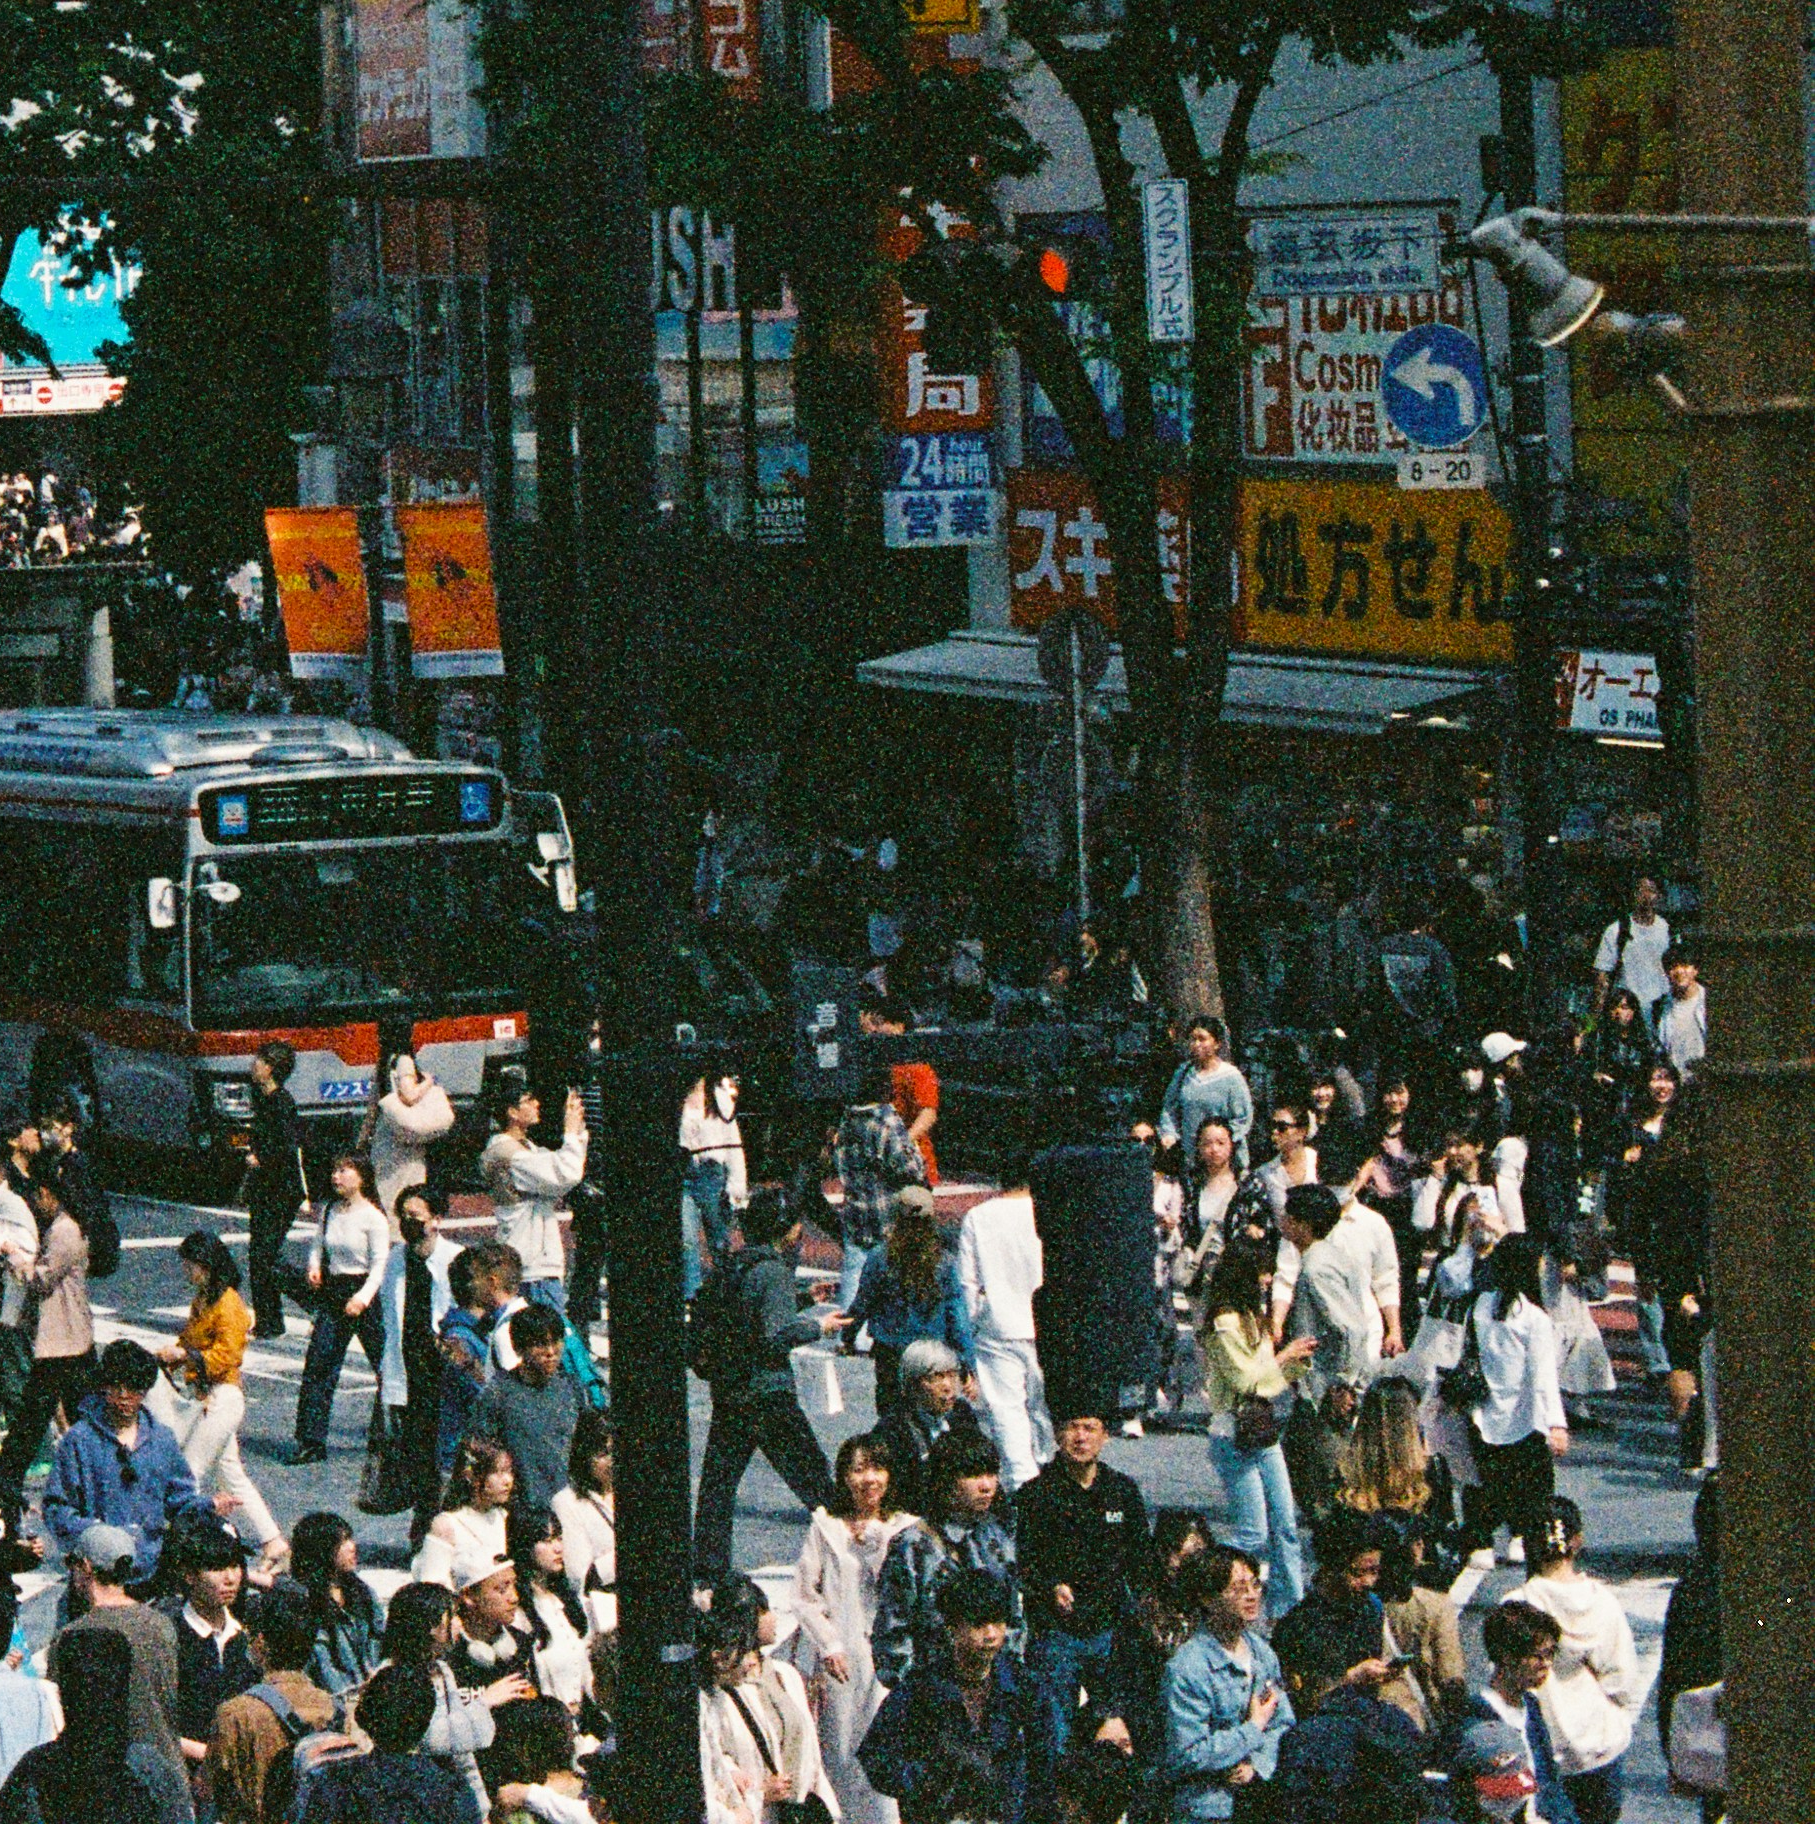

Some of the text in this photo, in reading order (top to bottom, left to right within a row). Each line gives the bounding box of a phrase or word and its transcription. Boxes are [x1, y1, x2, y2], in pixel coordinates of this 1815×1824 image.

[1294, 339, 1383, 393] Cosm
[1298, 400, 1407, 454] 化粧品
[899, 436, 943, 487] 24
[902, 493, 991, 540] 営業
[1578, 658, 1656, 700] オーエ
[1625, 709, 1656, 728] PHA
[323, 1079, 371, 1098] ノンス
